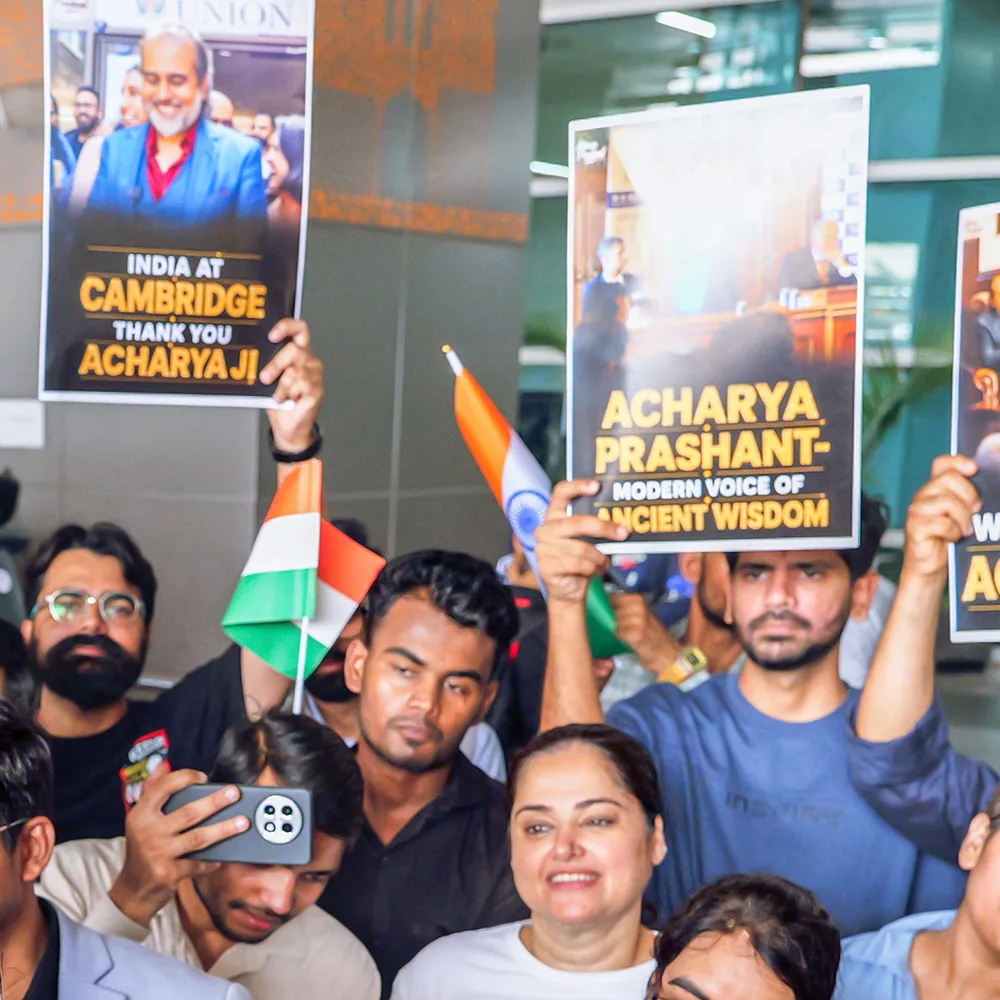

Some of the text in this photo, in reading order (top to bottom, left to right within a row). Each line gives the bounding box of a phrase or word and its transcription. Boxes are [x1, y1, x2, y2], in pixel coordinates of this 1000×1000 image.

[127, 253, 225, 279] INDIA AT
[80, 275, 267, 319] CAMBRIDGE
[112, 320, 233, 345] THANK YOU
[601, 379, 820, 430] ACHARYA
[595, 426, 831, 475] PRASHANT-
[613, 474, 805, 501] MODERN VOICE OF
[711, 499, 830, 531] WISDOM
